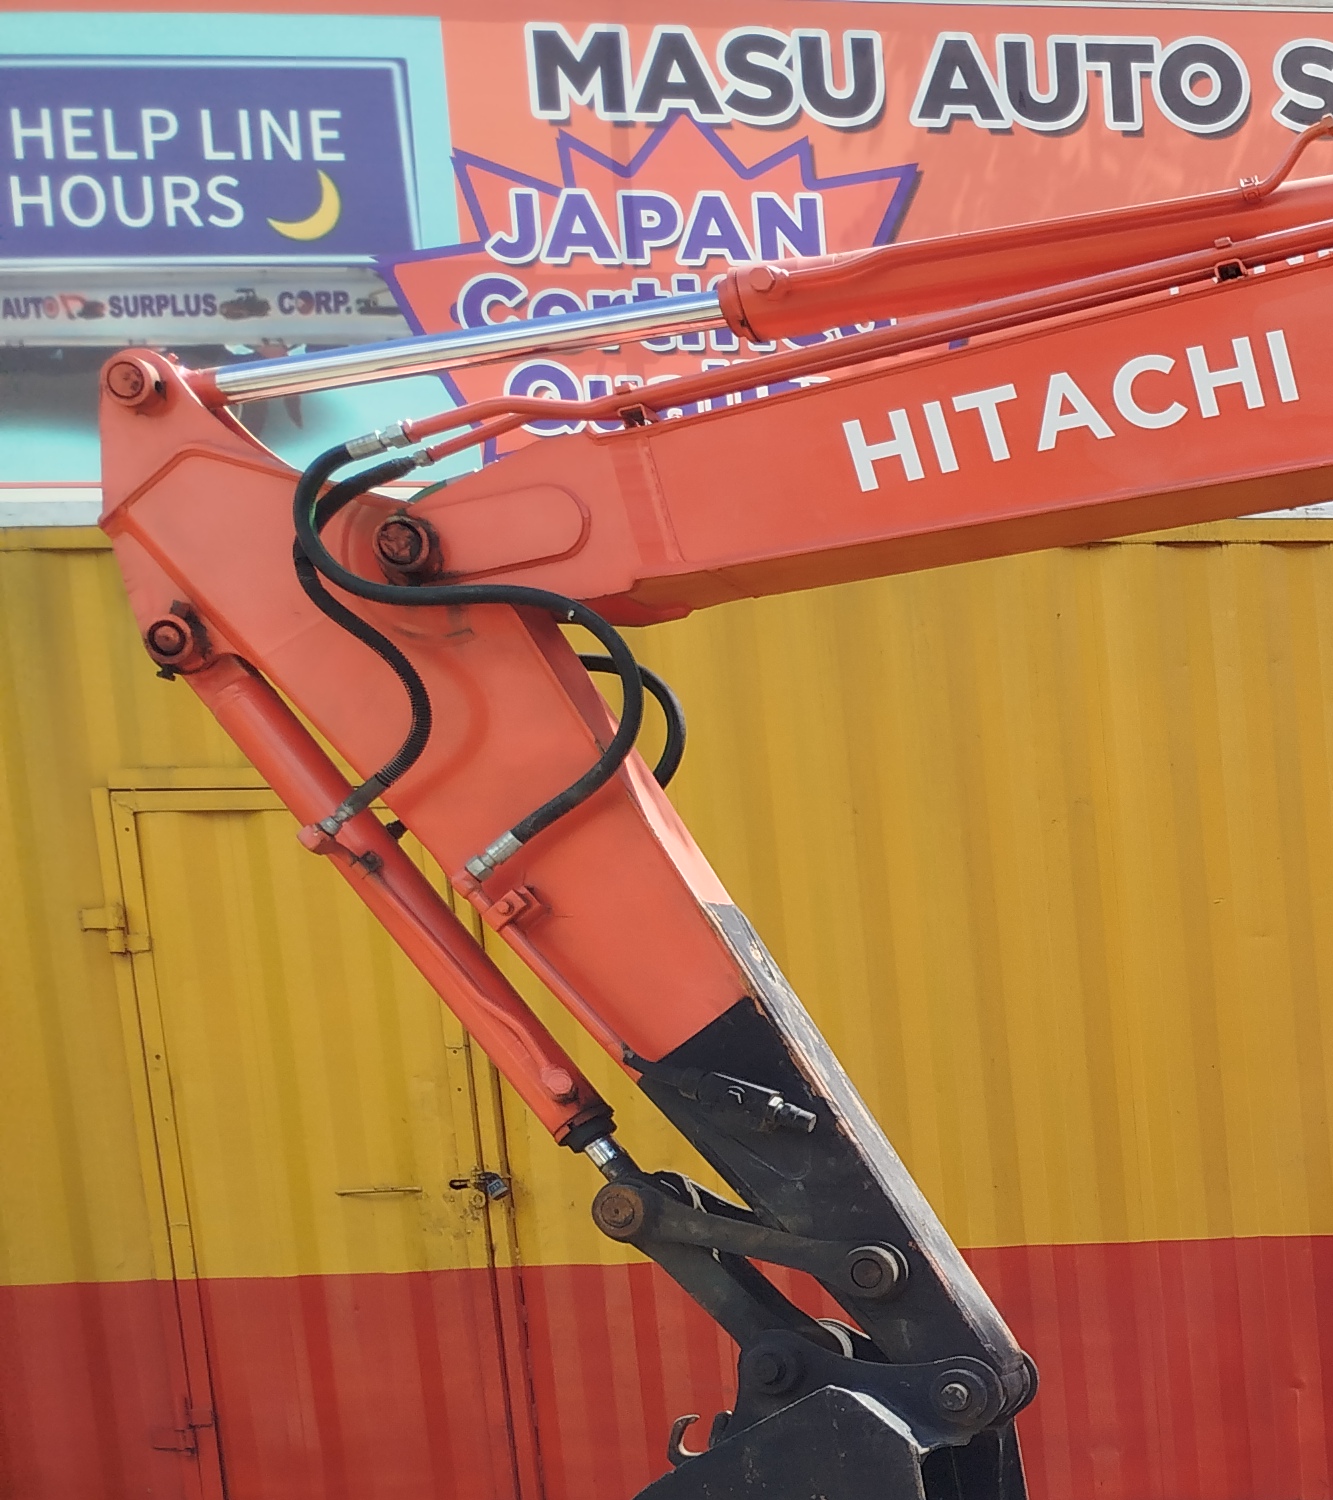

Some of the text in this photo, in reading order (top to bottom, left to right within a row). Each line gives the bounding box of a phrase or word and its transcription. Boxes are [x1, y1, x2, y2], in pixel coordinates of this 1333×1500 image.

[525, 24, 886, 126] MASU
[910, 31, 1250, 133] AUTO
[11, 108, 346, 161] HELP LINE
[9, 174, 245, 228] HOURS
[484, 188, 825, 265] JAPAN
[2, 296, 60, 319] AUTO
[108, 293, 217, 318] SURPLUS
[842, 329, 1300, 492] HITACHI
